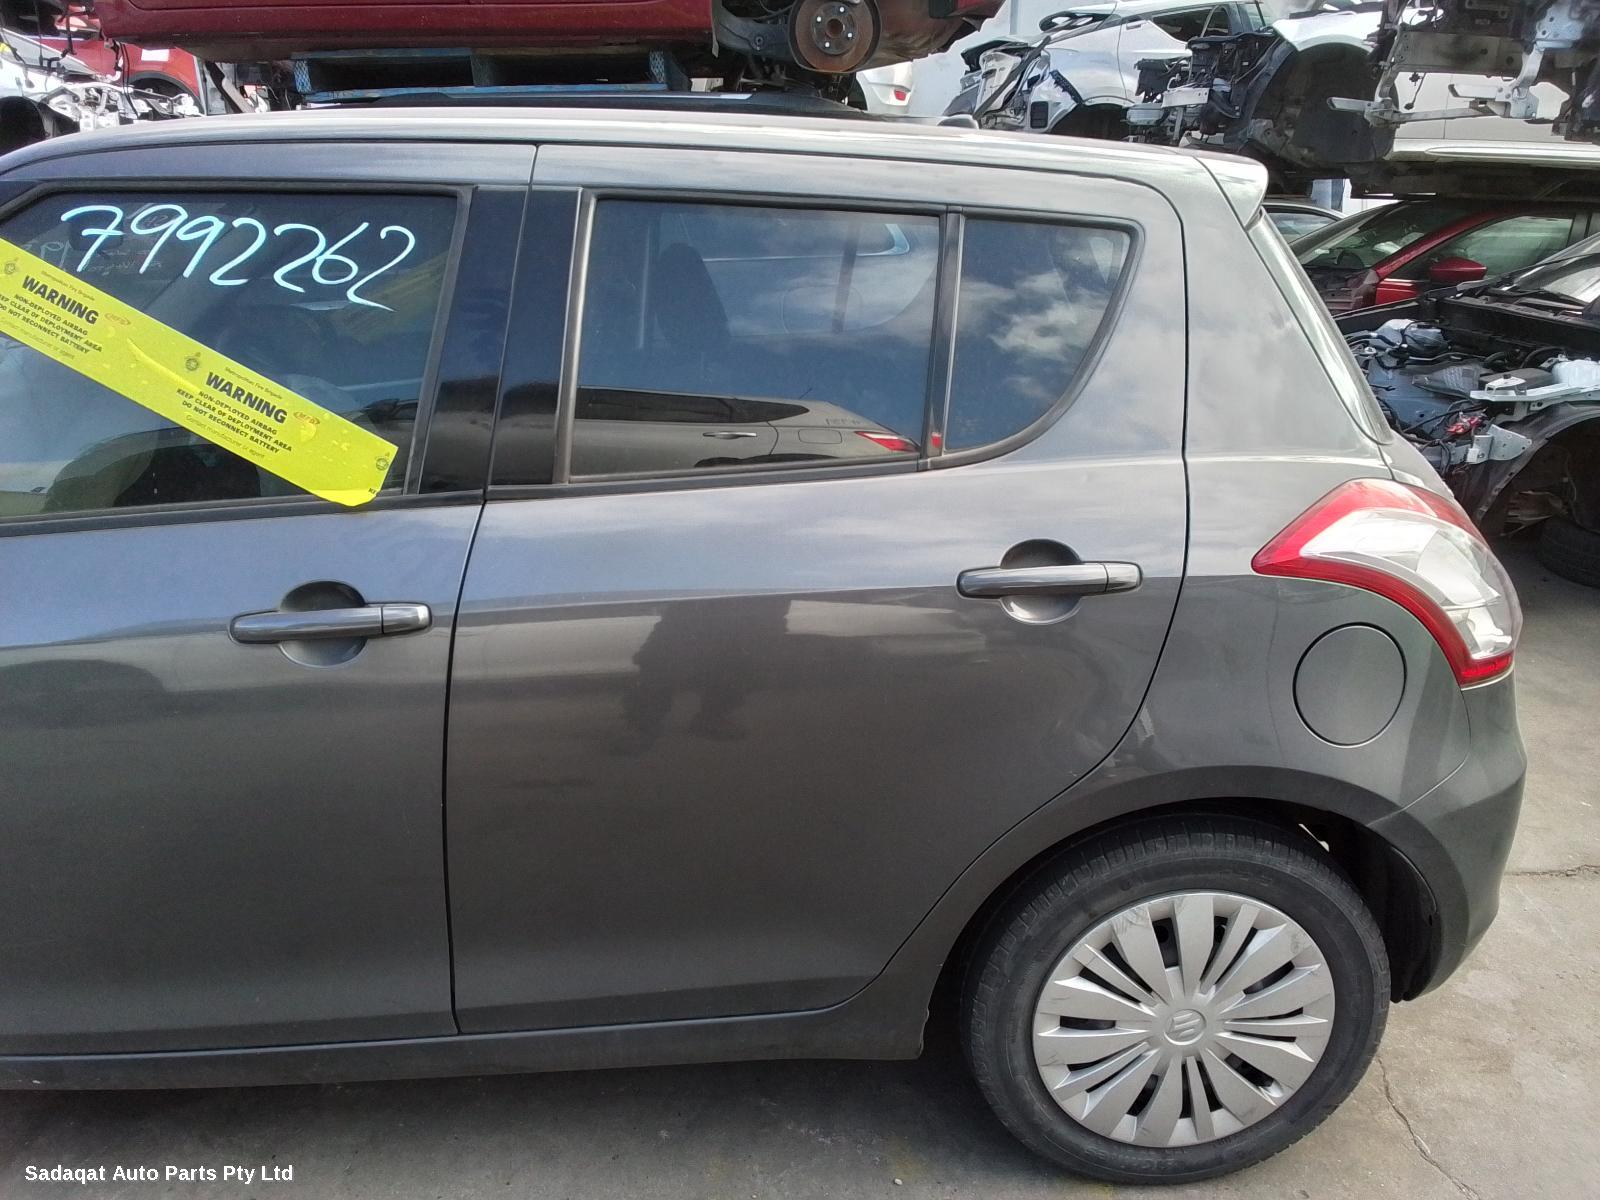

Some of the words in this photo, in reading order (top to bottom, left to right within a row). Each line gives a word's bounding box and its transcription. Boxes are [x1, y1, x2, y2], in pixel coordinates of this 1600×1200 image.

[61, 203, 414, 312] 7992262
[15, 294, 61, 321] NON-DEPLOYED
[62, 319, 88, 336] AIRBAG
[22, 276, 99, 324] WARNING
[8, 309, 21, 319] NOT
[22, 316, 59, 338] RECONNECT
[60, 336, 89, 354] BATTERY
[10, 301, 30, 314] CLEAR
[40, 317, 83, 342] DEPLOYMENT
[84, 340, 102, 352] AREA
[177, 388, 194, 400] KEEP
[194, 398, 217, 412] CLEAR
[227, 415, 273, 442] DEPLOYMENT
[273, 439, 292, 452] AREA
[199, 391, 249, 420] NON-DEPLOYED
[250, 418, 278, 435] AIRBAG
[205, 373, 288, 423] WARNING
[182, 401, 192, 409] DO
[193, 407, 207, 416] NOT
[208, 414, 248, 438] RECONNECT
[249, 435, 279, 454] BATTERY
